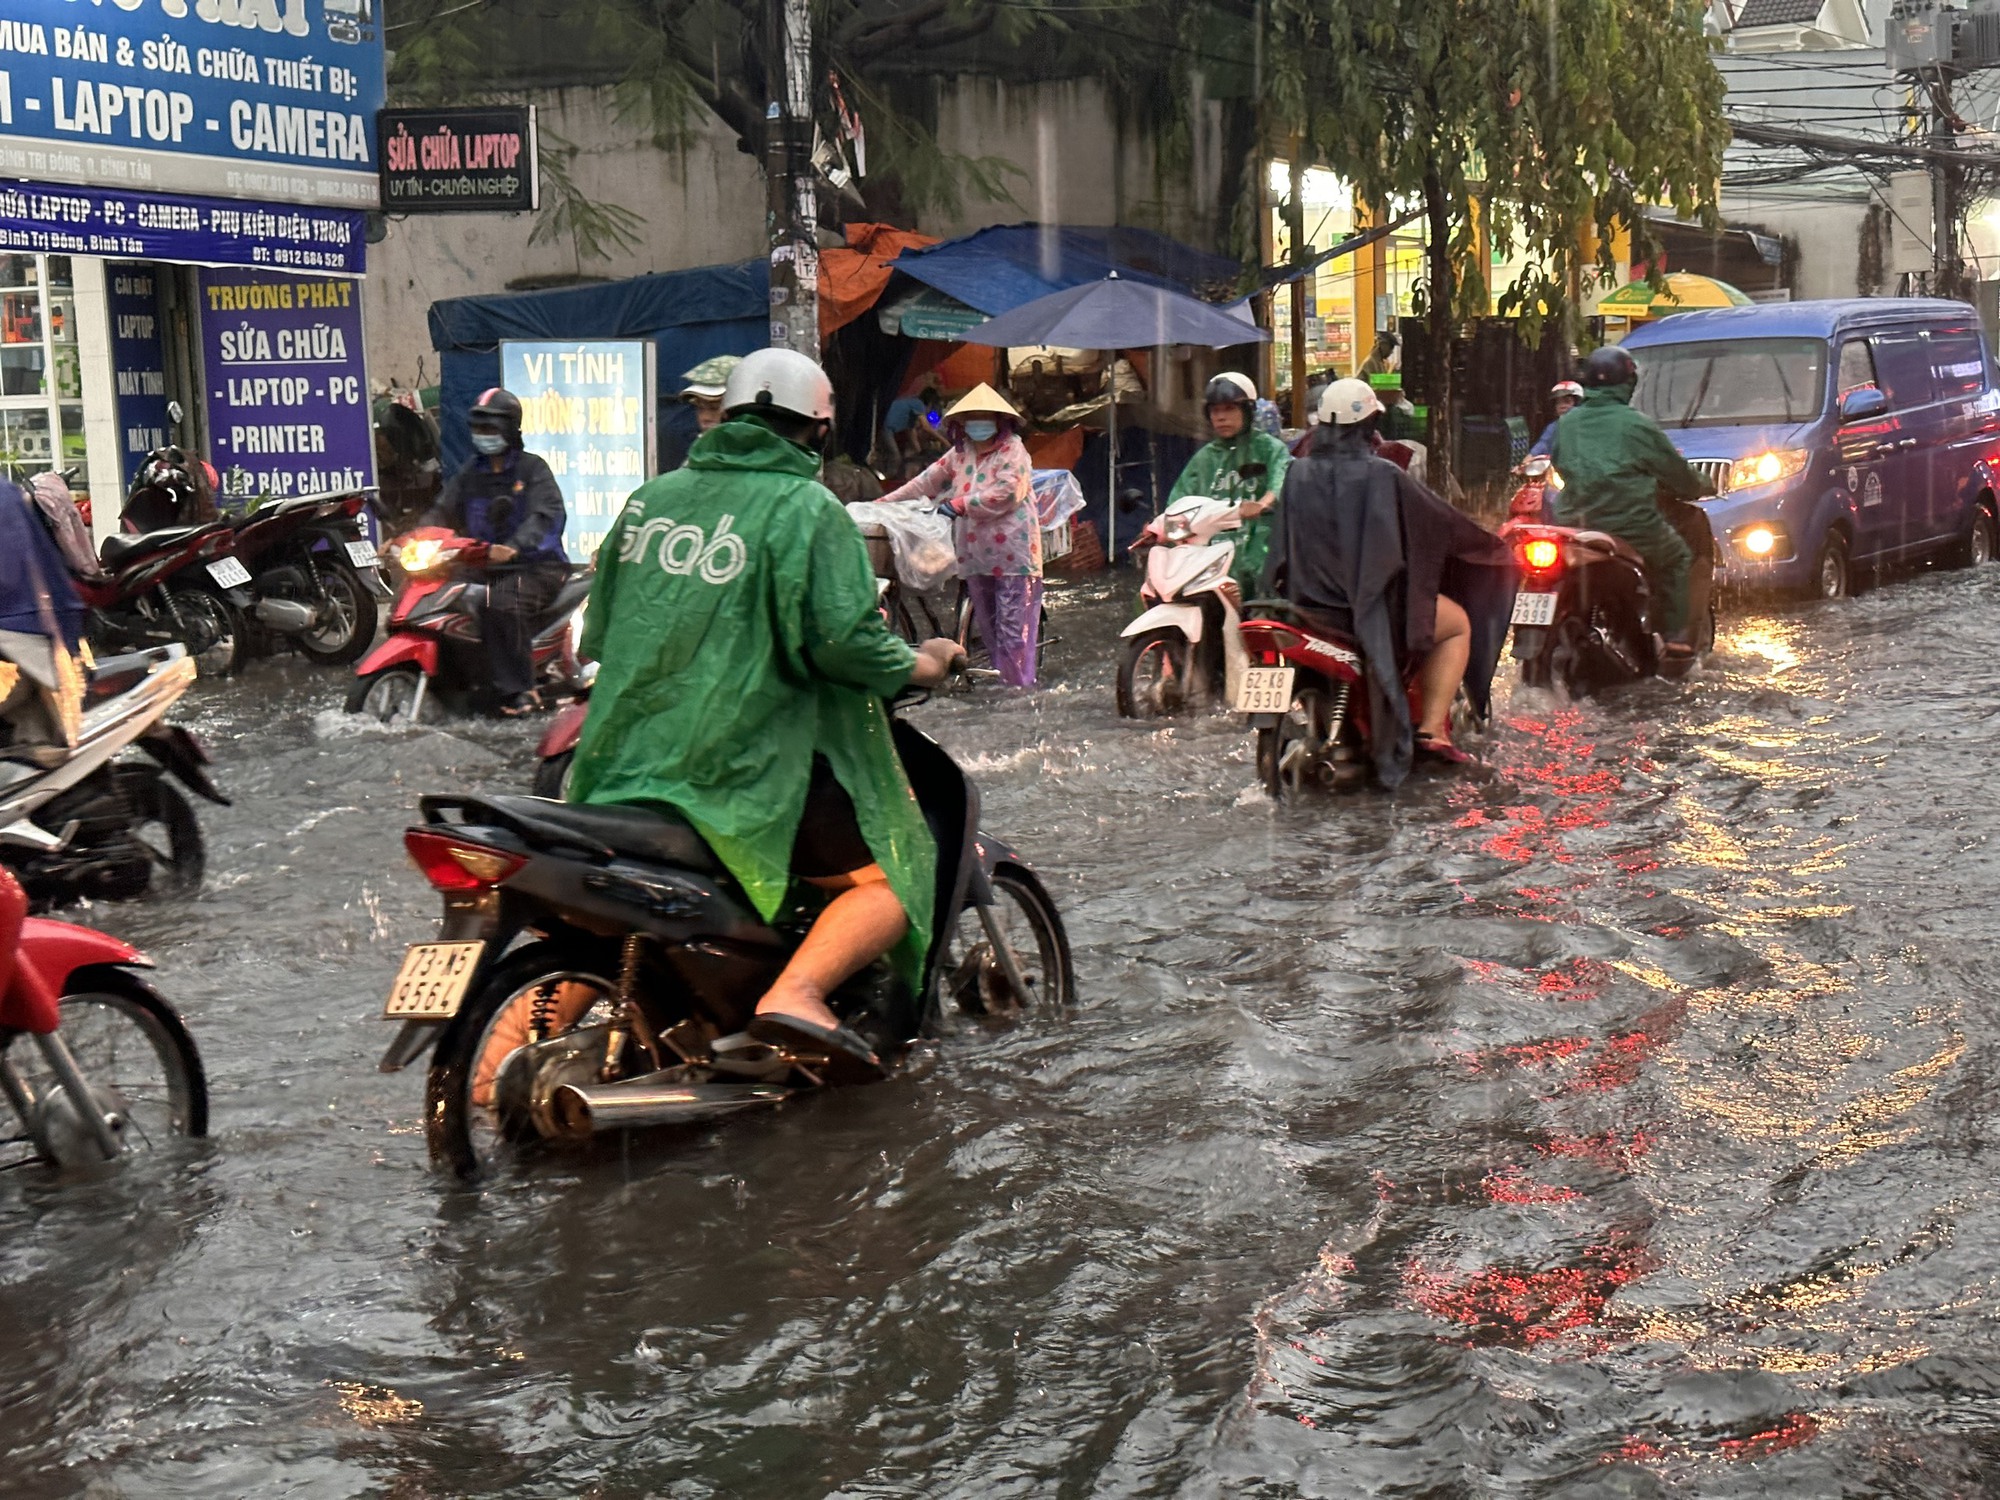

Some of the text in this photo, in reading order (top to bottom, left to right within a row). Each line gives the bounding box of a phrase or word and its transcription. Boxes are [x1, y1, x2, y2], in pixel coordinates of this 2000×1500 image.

[0, 20, 358, 101] MUA BÁN & SỬA CHỮA THIẾT BỊ:
[51, 77, 193, 142] LAPTOP
[230, 99, 370, 162] CAMERA
[387, 121, 520, 171] SỬA CHỮA LAPTOP
[391, 180, 405, 196] UY
[407, 176, 422, 196] TÍN
[431, 174, 476, 196] CHUYÊN
[478, 174, 519, 198] NGHIỆP
[31, 195, 91, 223] LAPTOP
[104, 201, 125, 225] PC
[138, 203, 200, 232] CAMERA
[212, 210, 240, 239] PHỤ
[243, 209, 275, 241] KIỆN
[312, 219, 350, 247] THOẠI
[31, 231, 49, 250] Trị
[90, 235, 119, 252] Bình
[122, 237, 144, 253] Tân
[274, 248, 301, 265] 0912
[303, 250, 323, 266] 684
[207, 279, 352, 311] TRƯỜNG PHÁT
[118, 314, 154, 339] LAPTOP
[220, 321, 347, 360] SỬA CHỮA
[523, 346, 624, 385] VI TÍNH
[118, 368, 139, 396] MÁY
[228, 377, 309, 406] LAPTOP
[329, 376, 359, 405] PC
[521, 386, 639, 435] RƯỜNG PHÁT
[128, 424, 149, 452] MÁY
[231, 425, 325, 453] PRINTER
[297, 467, 327, 493] CÀI
[575, 486, 602, 516] MÁY
[1513, 609, 1547, 623] 7999
[1246, 672, 1285, 689] 62-K8
[1243, 691, 1282, 709] 7930
